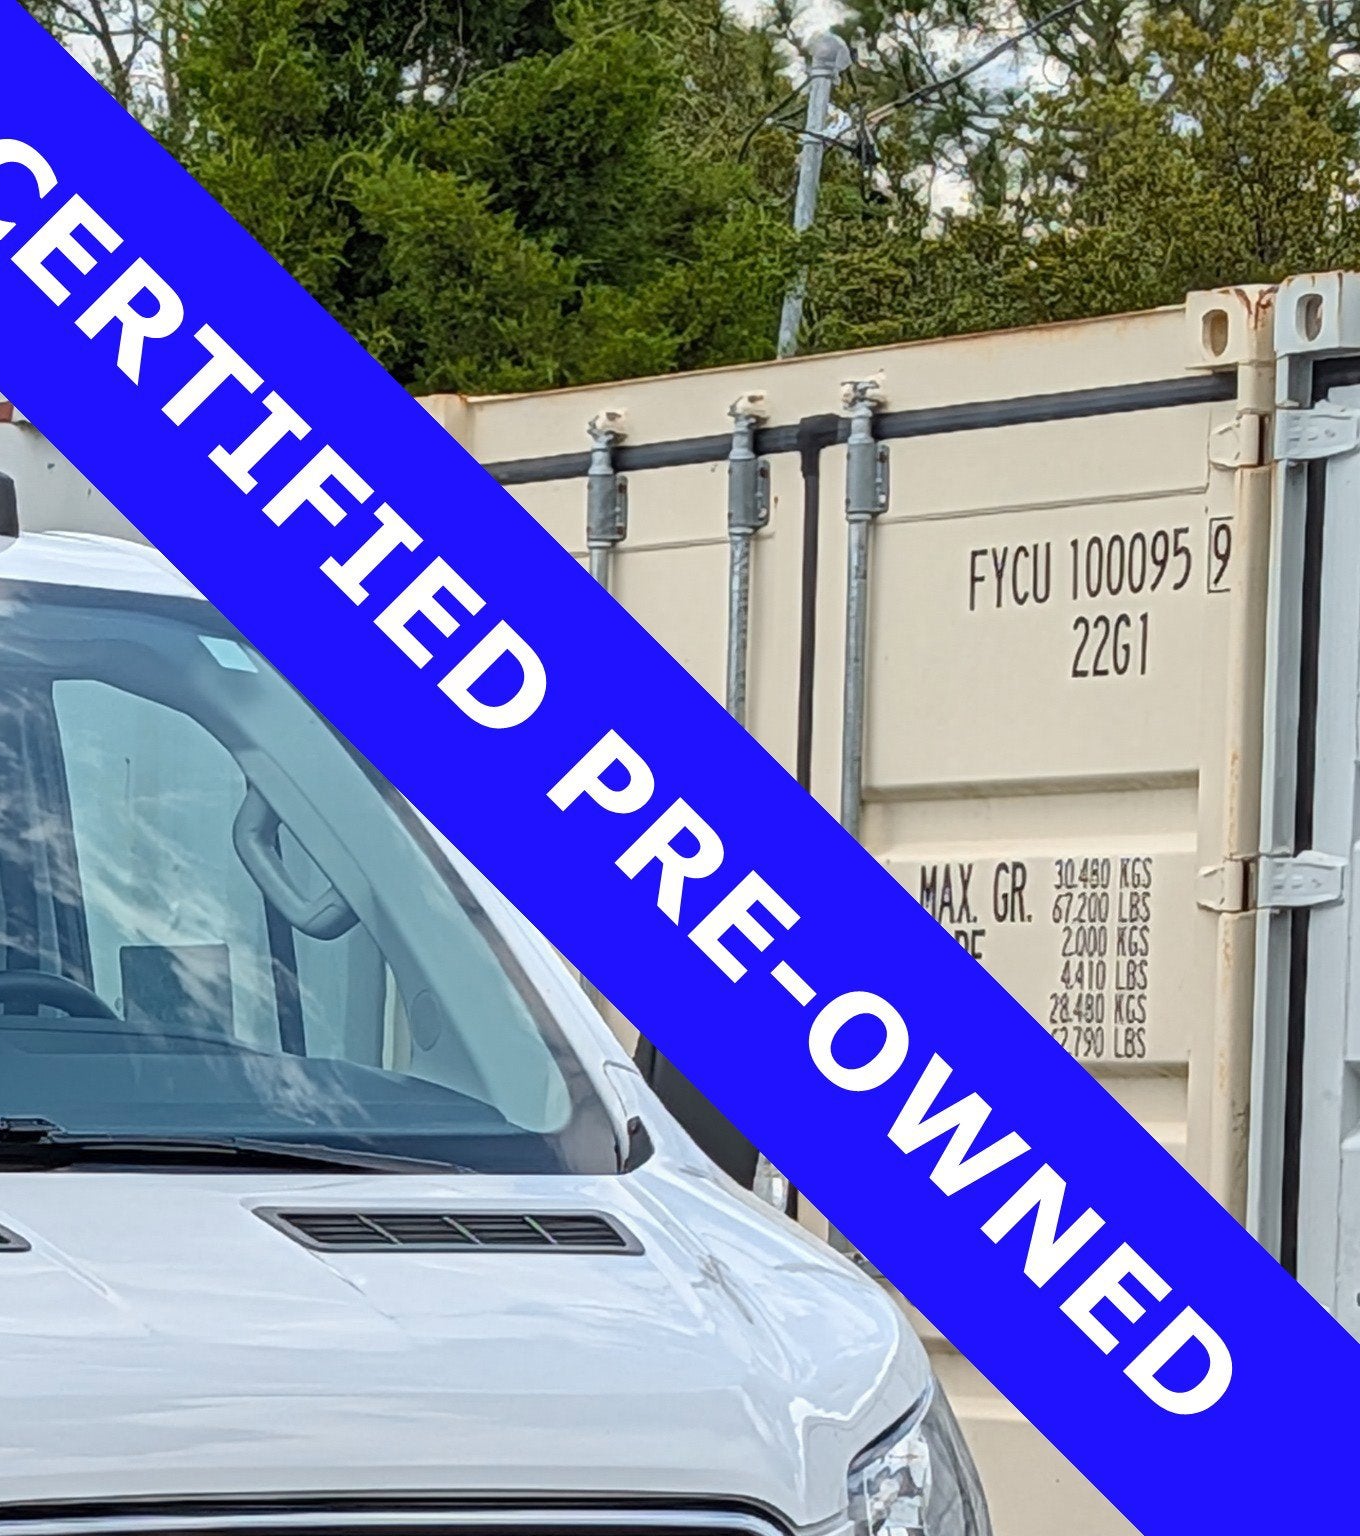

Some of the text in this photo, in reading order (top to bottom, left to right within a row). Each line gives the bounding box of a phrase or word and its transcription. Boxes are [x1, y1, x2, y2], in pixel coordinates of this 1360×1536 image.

[969, 521, 1233, 611] FYCU 100095 9
[1072, 612, 1148, 678] 22G1
[920, 862, 978, 924] MAX.
[993, 861, 1033, 923] GR.
[1119, 857, 1153, 889] KGS
[1117, 891, 1151, 924] LBS
[1116, 925, 1150, 957] KGS
[1115, 959, 1148, 990] LBS
[1114, 992, 1147, 1024] KGS
[1114, 1026, 1146, 1058] LBS
